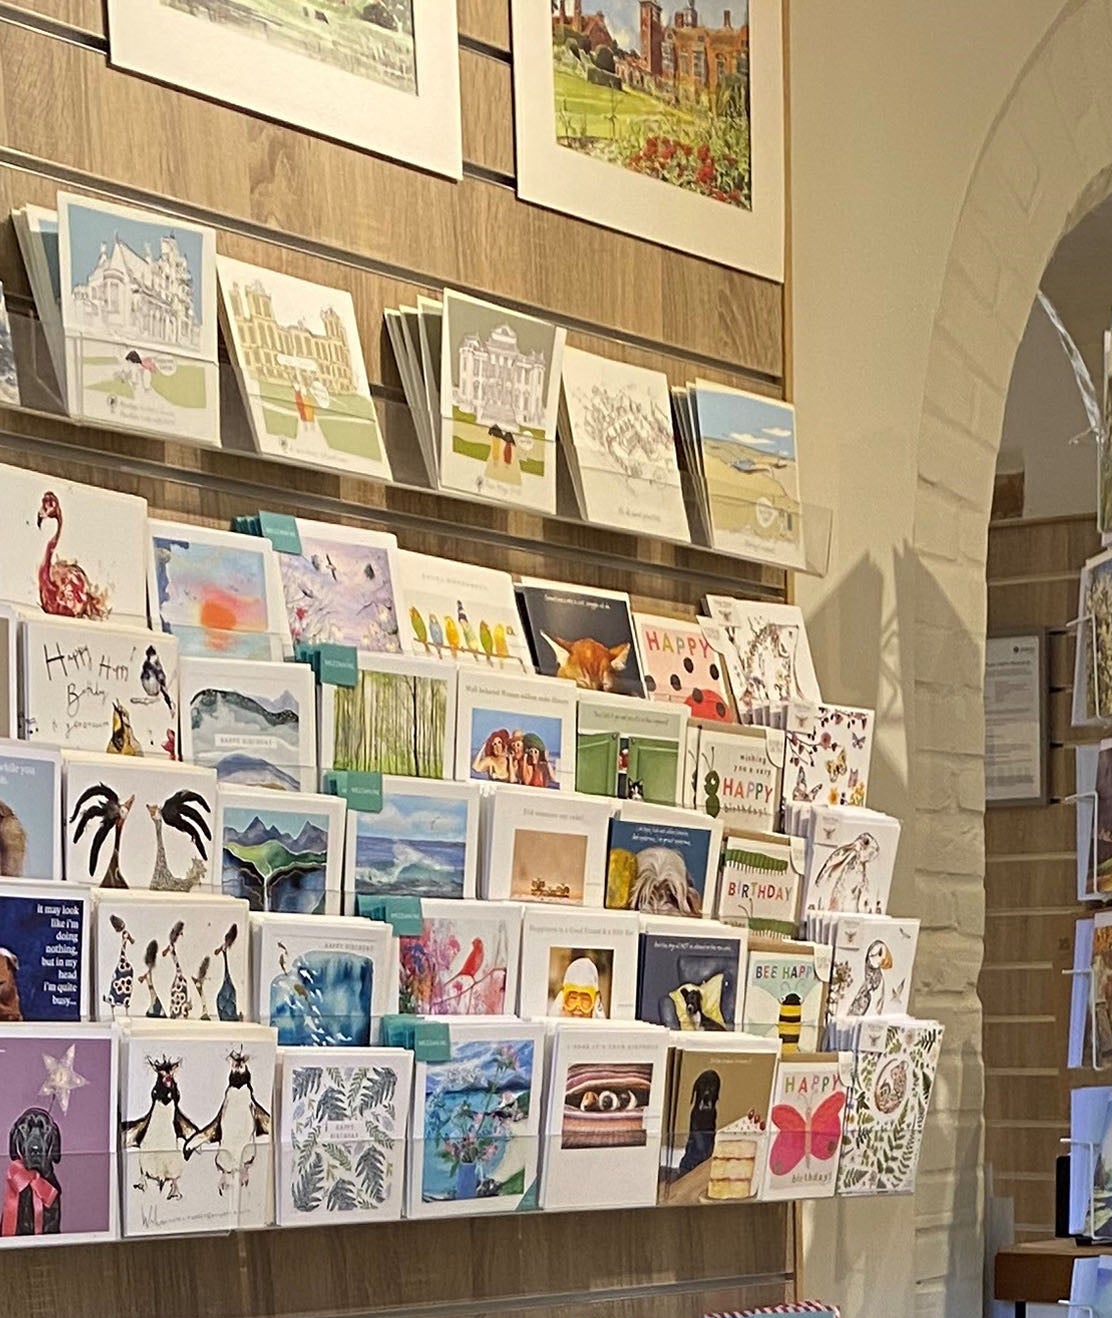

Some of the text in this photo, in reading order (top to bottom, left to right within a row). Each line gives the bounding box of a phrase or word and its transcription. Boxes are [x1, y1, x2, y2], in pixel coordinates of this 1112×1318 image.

[645, 631, 711, 659] HAPPY
[740, 753, 766, 766] wishing
[733, 765, 747, 775] you
[756, 769, 772, 778] very
[723, 777, 773, 803] HAPPY
[728, 881, 793, 901] BIRTHDAY
[44, 905, 61, 916] may
[62, 905, 80, 915] look
[50, 918, 79, 929] like i'm
[55, 930, 79, 943] doing
[41, 956, 78, 969] but in my
[58, 970, 77, 980] head
[755, 965, 817, 980] BEE HAPP
[43, 981, 78, 993] i'm quite
[785, 1073, 840, 1094] HAPPY
